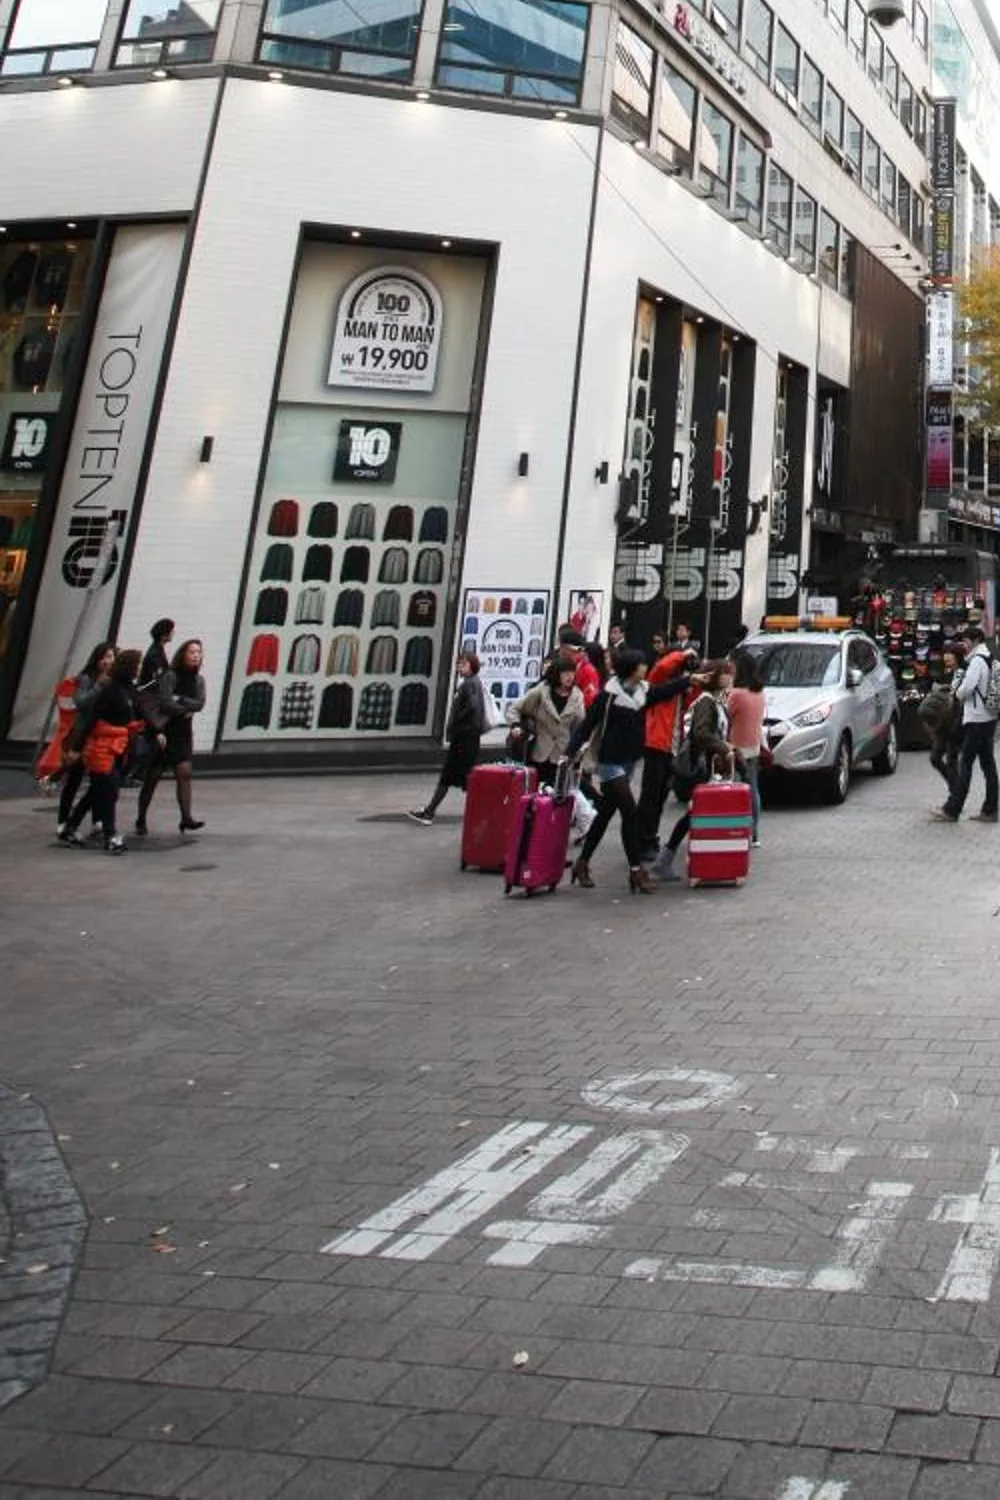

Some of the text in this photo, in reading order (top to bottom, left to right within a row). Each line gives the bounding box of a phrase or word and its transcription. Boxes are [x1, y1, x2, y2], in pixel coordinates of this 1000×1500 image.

[377, 292, 411, 313] 100
[343, 320, 435, 344] MAN TO MAN
[358, 345, 429, 371] 19,900
[73, 324, 143, 510] TOPTEN
[12, 418, 48, 458] 10
[348, 426, 392, 468] 10
